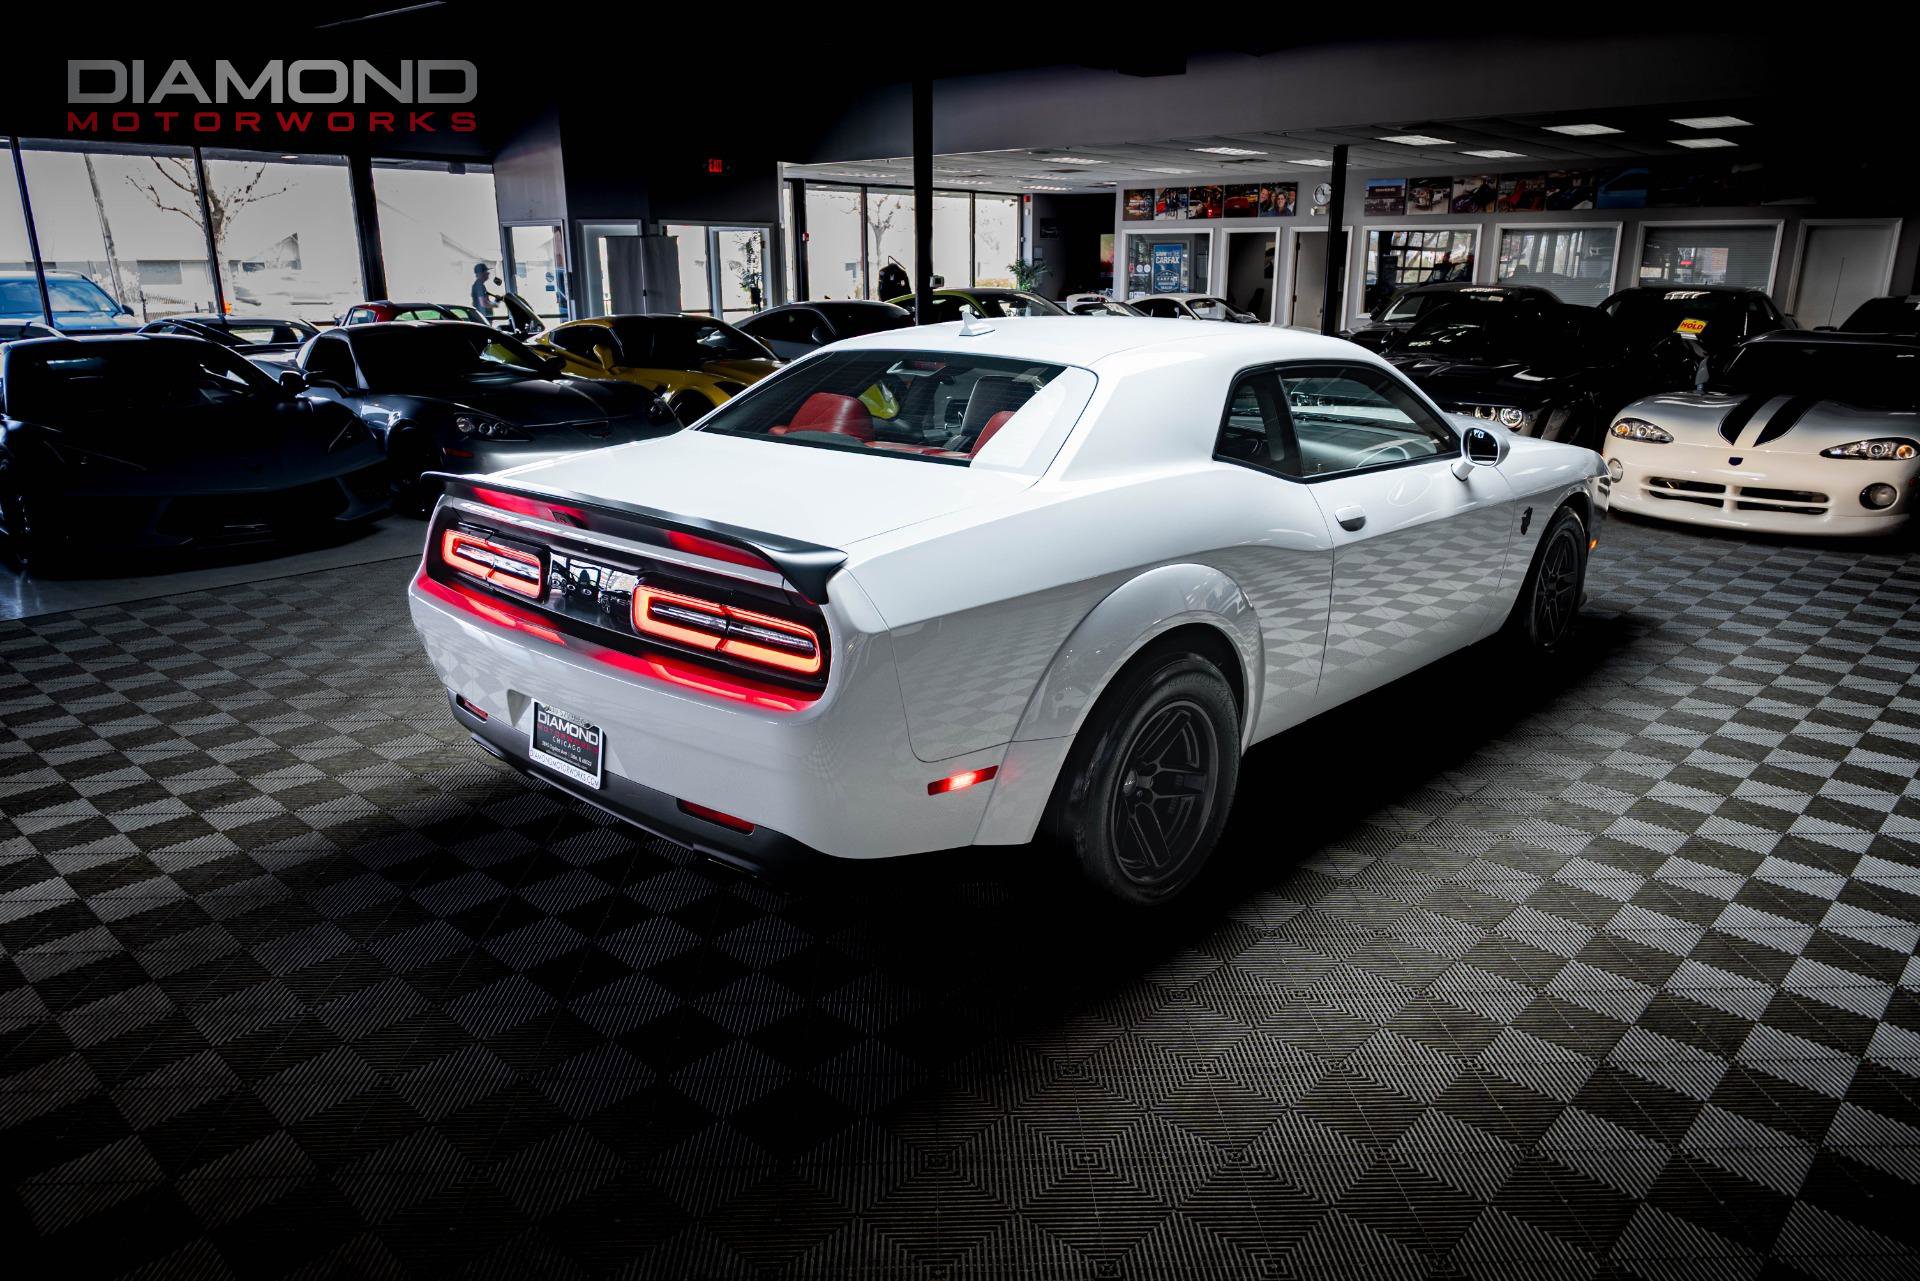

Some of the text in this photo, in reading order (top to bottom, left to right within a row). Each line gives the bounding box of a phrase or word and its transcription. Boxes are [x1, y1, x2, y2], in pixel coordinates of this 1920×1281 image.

[1155, 256, 1179, 264] CARFAX
[537, 710, 599, 746] DIAMOND
[552, 736, 581, 753] CHICAGO
